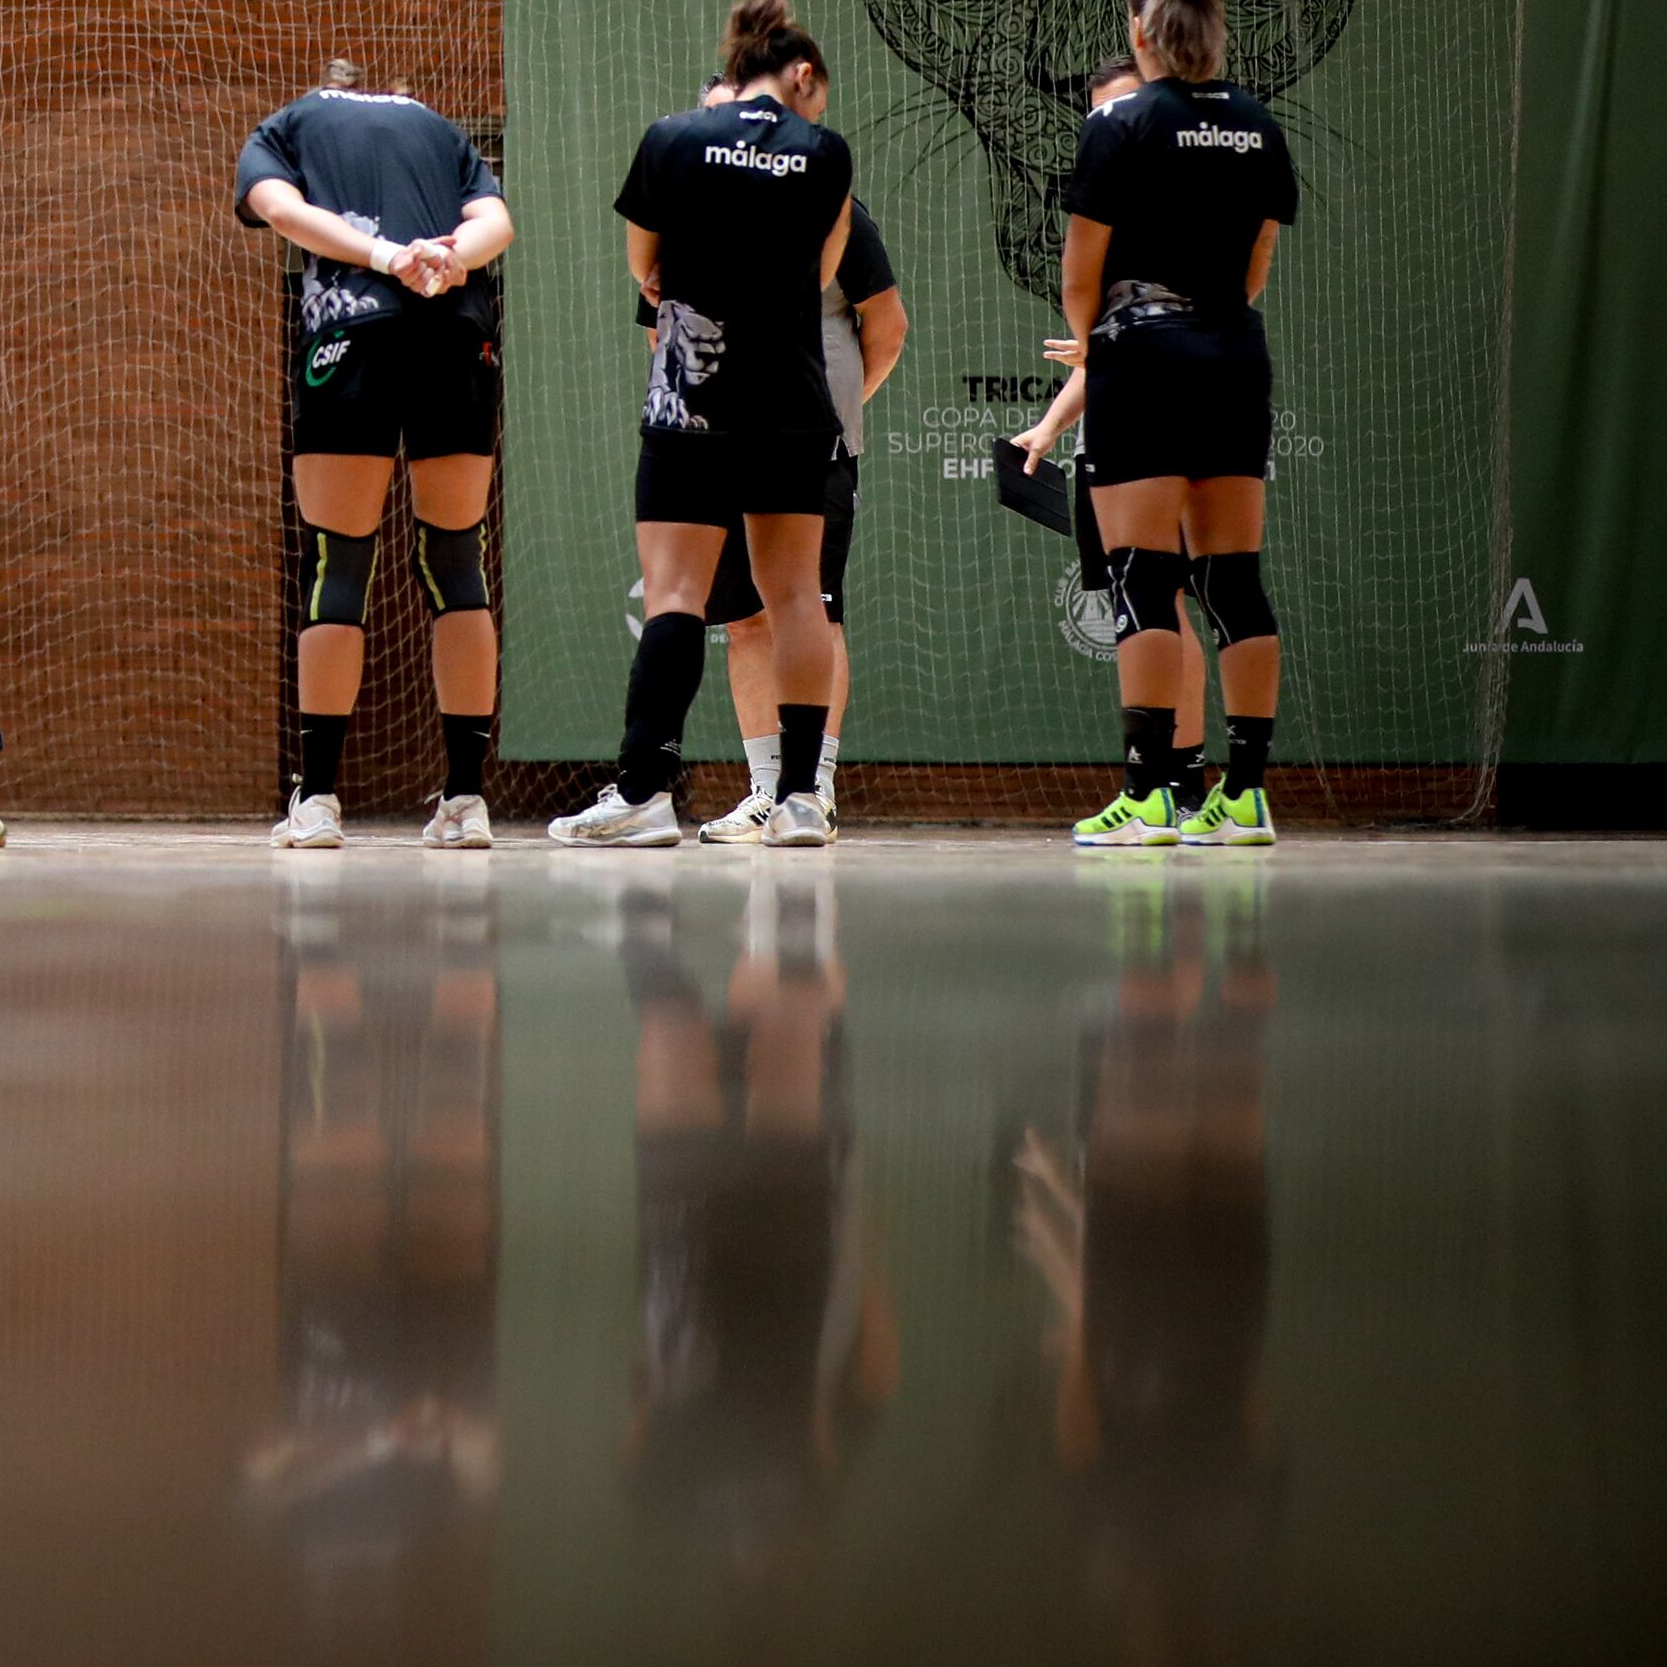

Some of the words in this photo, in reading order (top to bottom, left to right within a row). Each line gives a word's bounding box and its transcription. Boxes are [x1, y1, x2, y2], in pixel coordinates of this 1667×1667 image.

[312, 340, 351, 368] CSIF
[923, 407, 997, 430] COPA
[1006, 409, 1039, 431] DE
[943, 458, 995, 480] EHF
[1503, 641, 1518, 652] de
[1520, 639, 1584, 652] Andalucía
